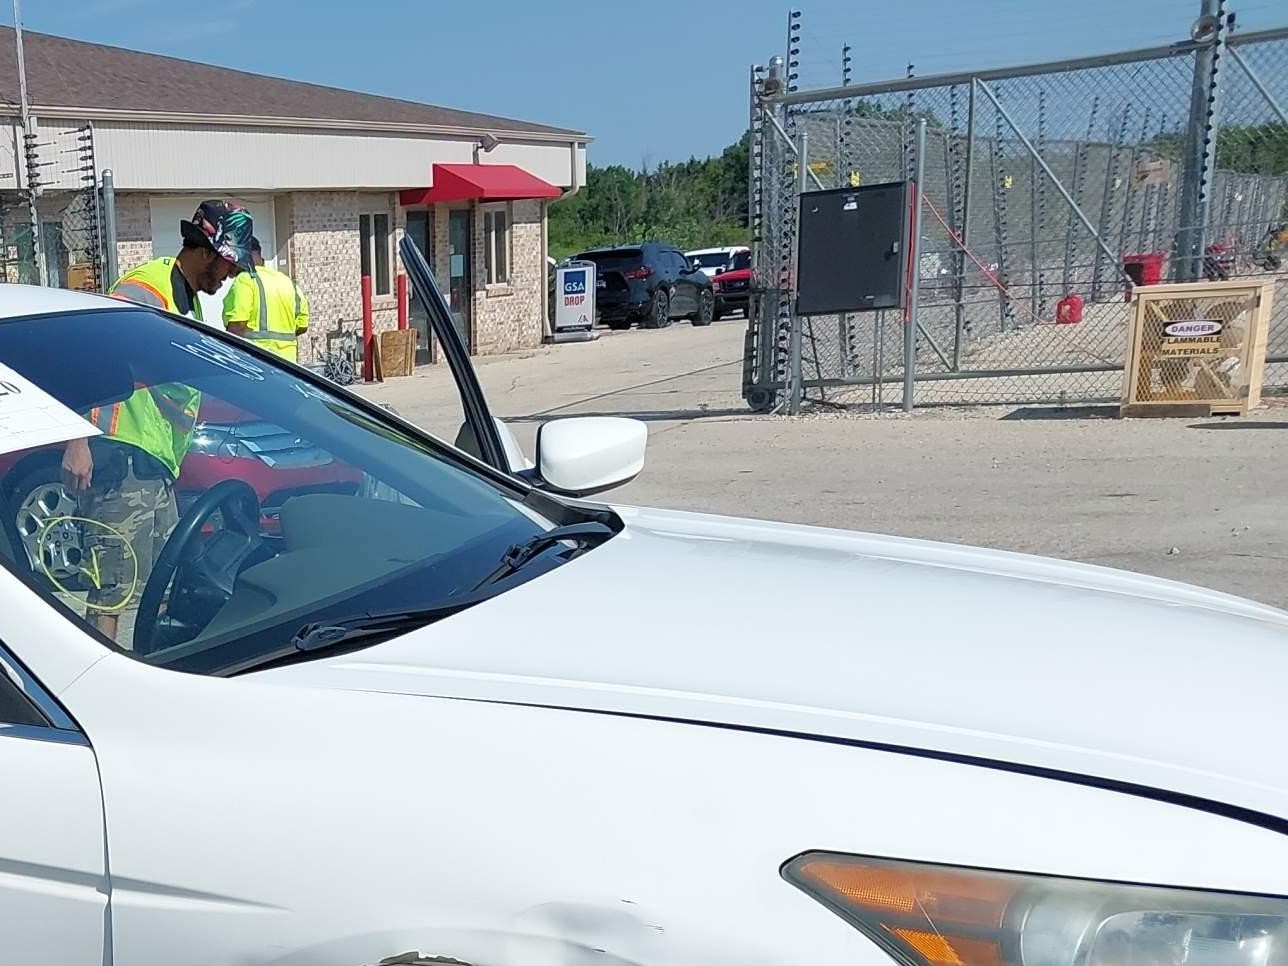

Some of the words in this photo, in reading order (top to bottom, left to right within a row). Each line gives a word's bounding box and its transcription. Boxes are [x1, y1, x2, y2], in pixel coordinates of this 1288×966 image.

[564, 281, 585, 292] GSA
[564, 295, 585, 307] DROP
[1171, 324, 1215, 333] DANGER
[1162, 347, 1219, 356] MATERIALS
